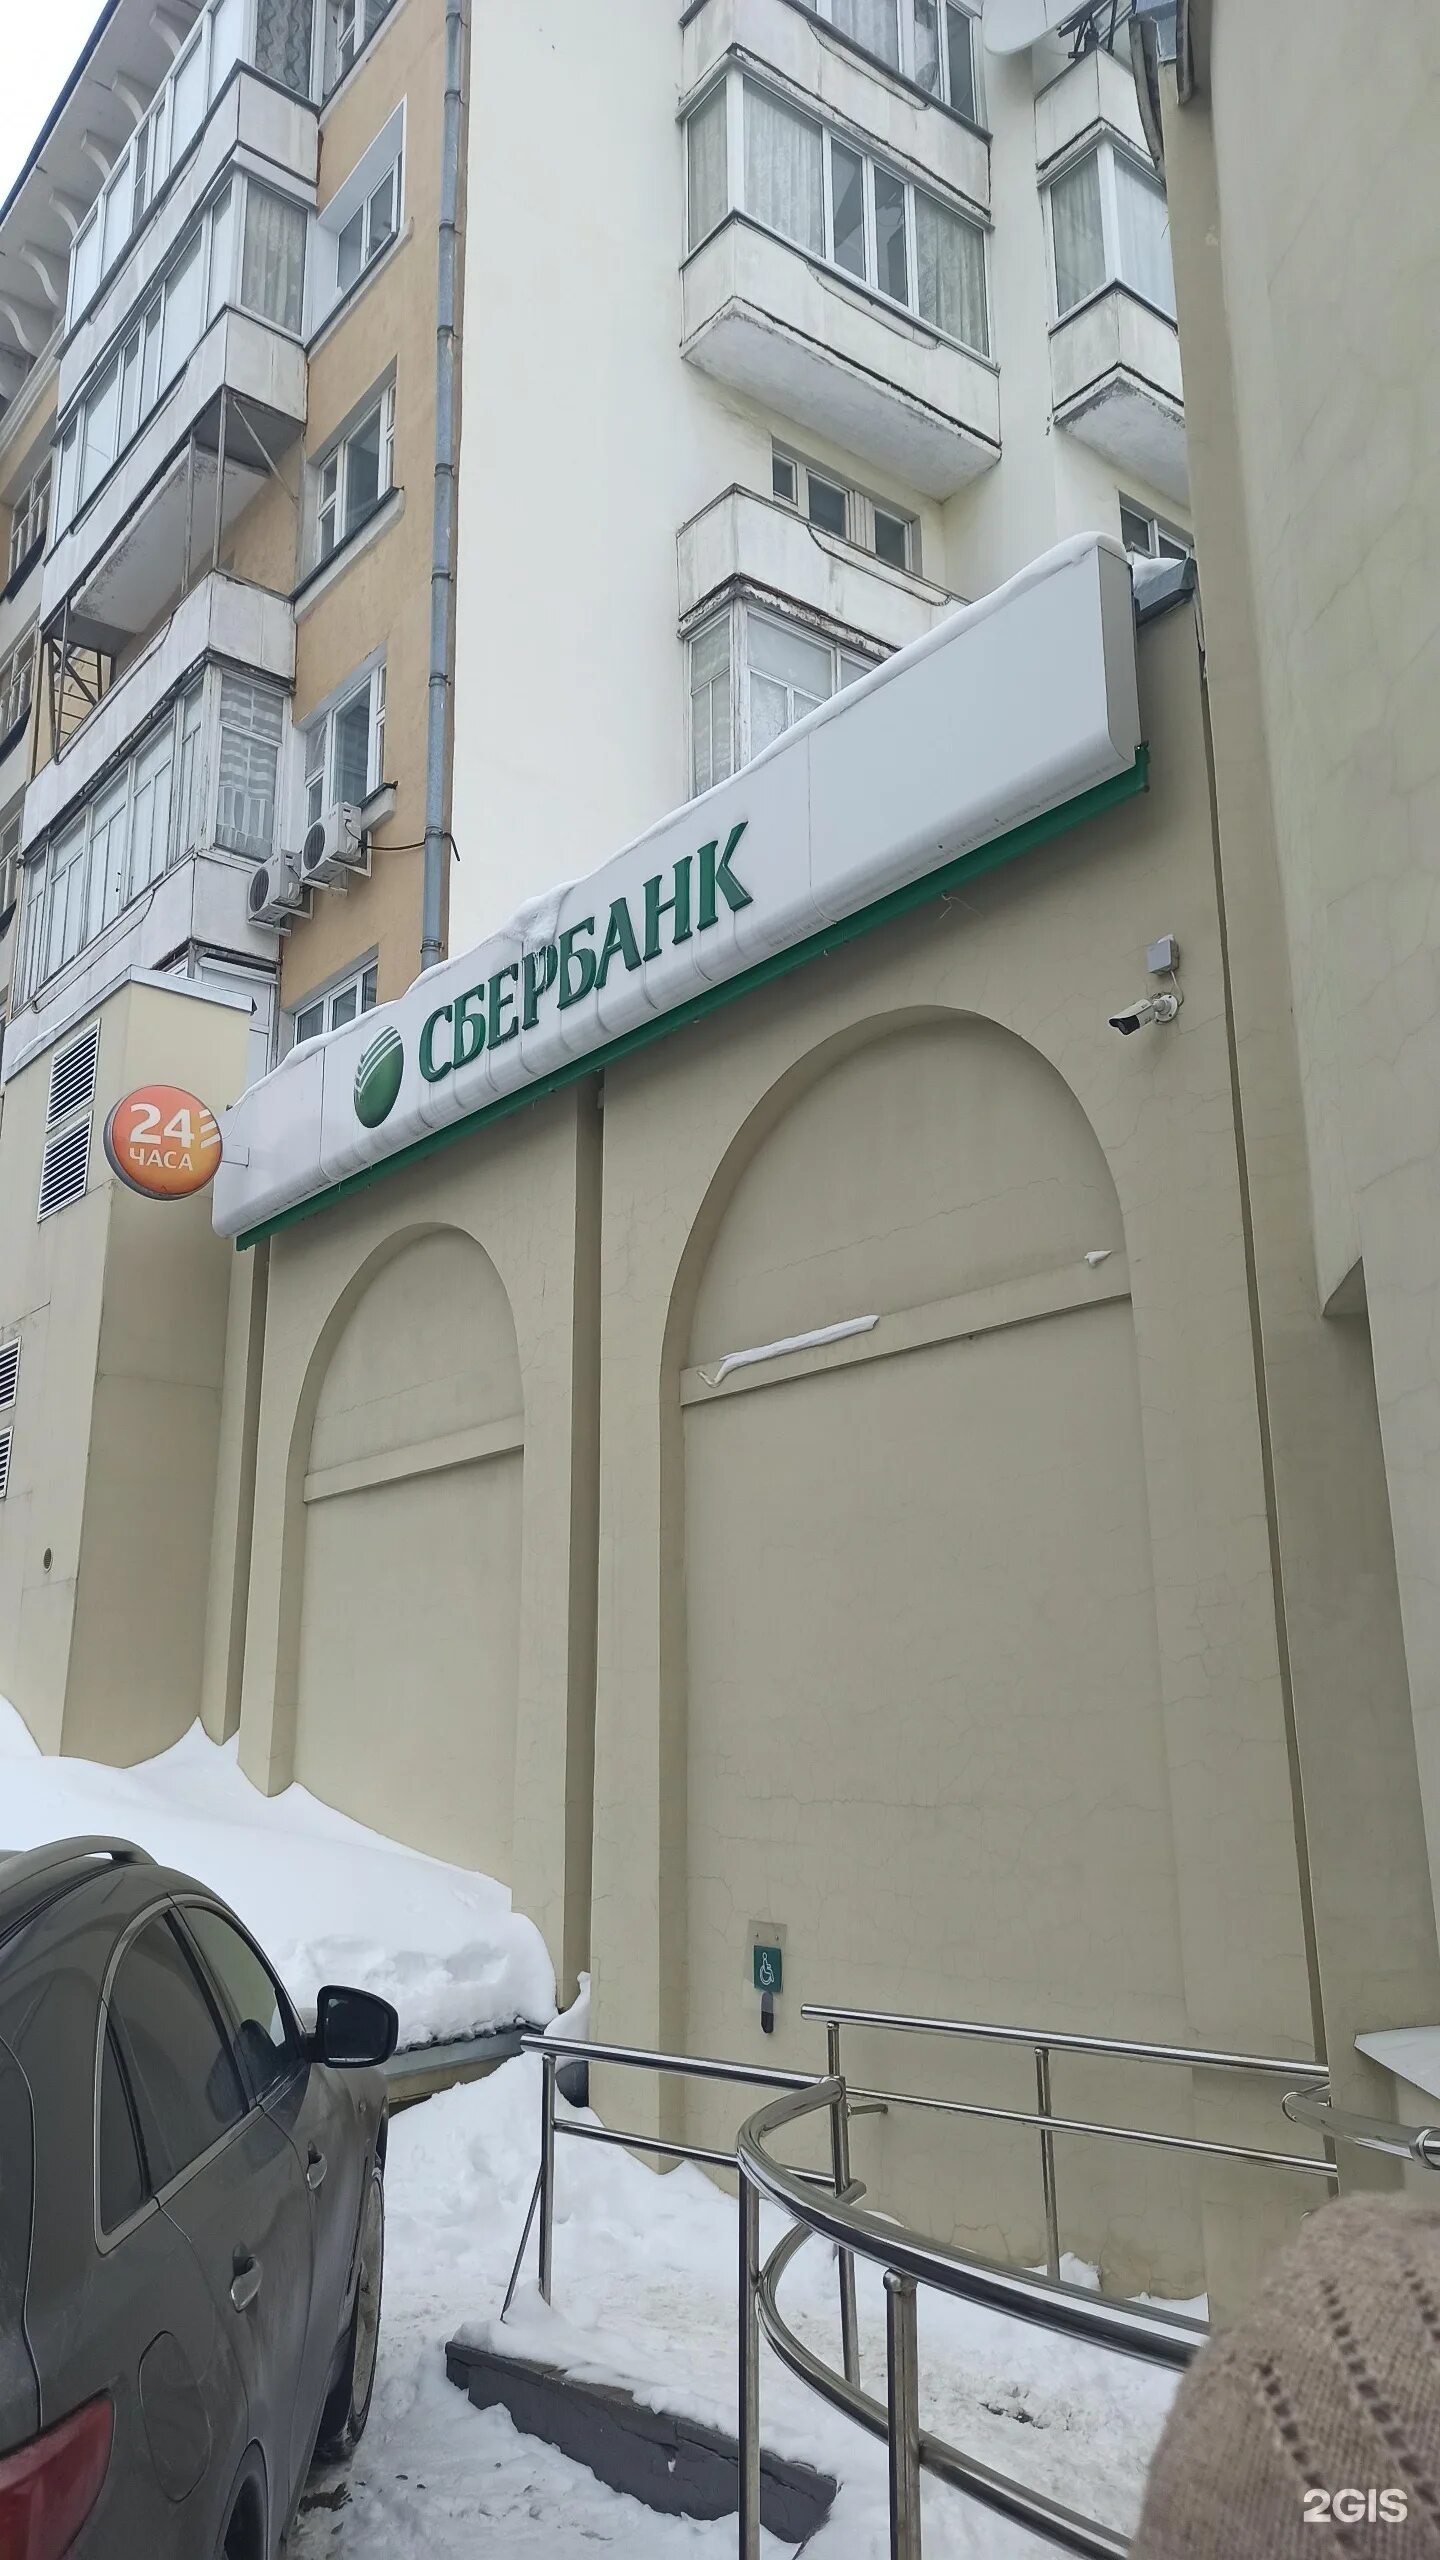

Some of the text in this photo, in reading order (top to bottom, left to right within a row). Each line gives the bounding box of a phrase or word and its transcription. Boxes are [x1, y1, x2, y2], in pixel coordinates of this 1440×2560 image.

[419, 821, 754, 1083] СБЕРБАНК
[130, 1103, 195, 1149] 24
[129, 1147, 193, 1171] ЧАСА
